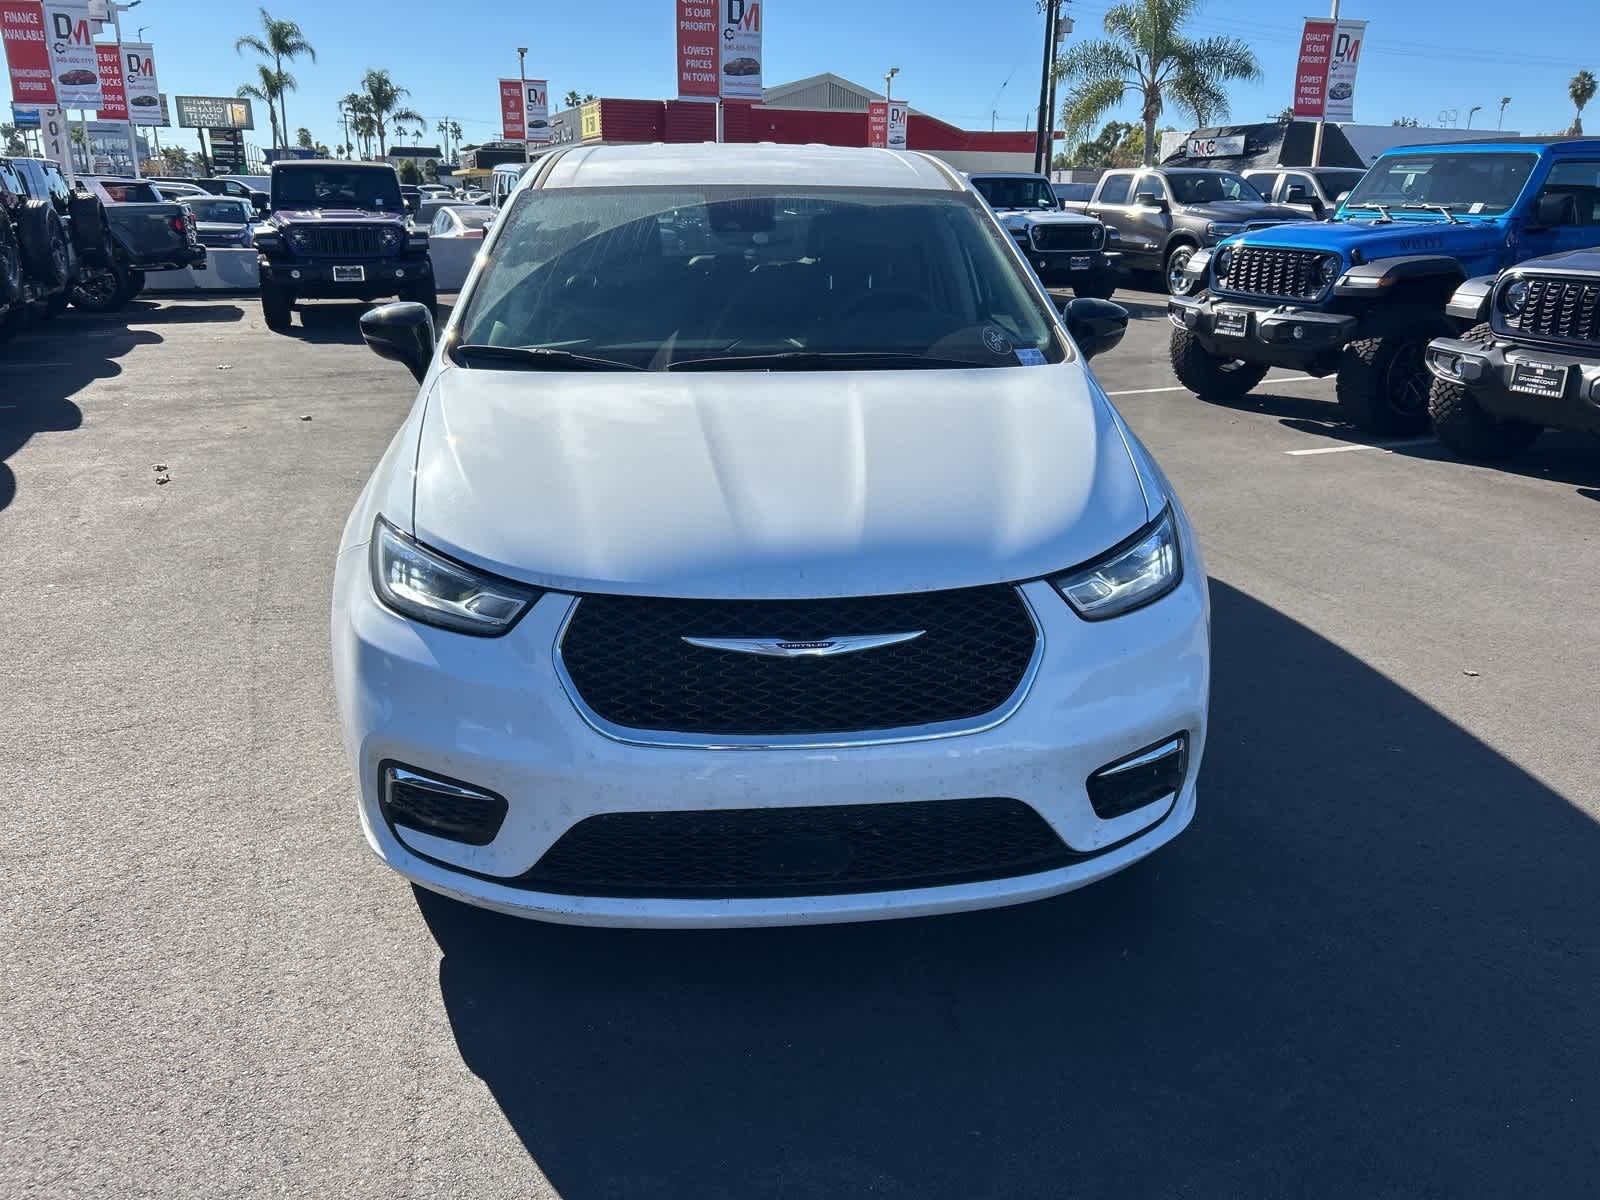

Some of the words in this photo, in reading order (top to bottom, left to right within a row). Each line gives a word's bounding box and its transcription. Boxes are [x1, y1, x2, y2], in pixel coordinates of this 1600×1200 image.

[4, 11, 38, 24] FINANCE
[685, 8, 693, 17] IS
[694, 8, 711, 17] OUR
[681, 20, 716, 31] PRIORITY
[4, 28, 45, 41] AVAILABLE
[1305, 32, 1330, 42] QUALITY
[683, 45, 714, 56] LOWEST
[686, 59, 712, 69] PRICES
[1301, 55, 1326, 64] PRIORITY
[100, 65, 112, 74] ARS
[693, 72, 716, 82] TOWN
[101, 78, 121, 87] RUCKS
